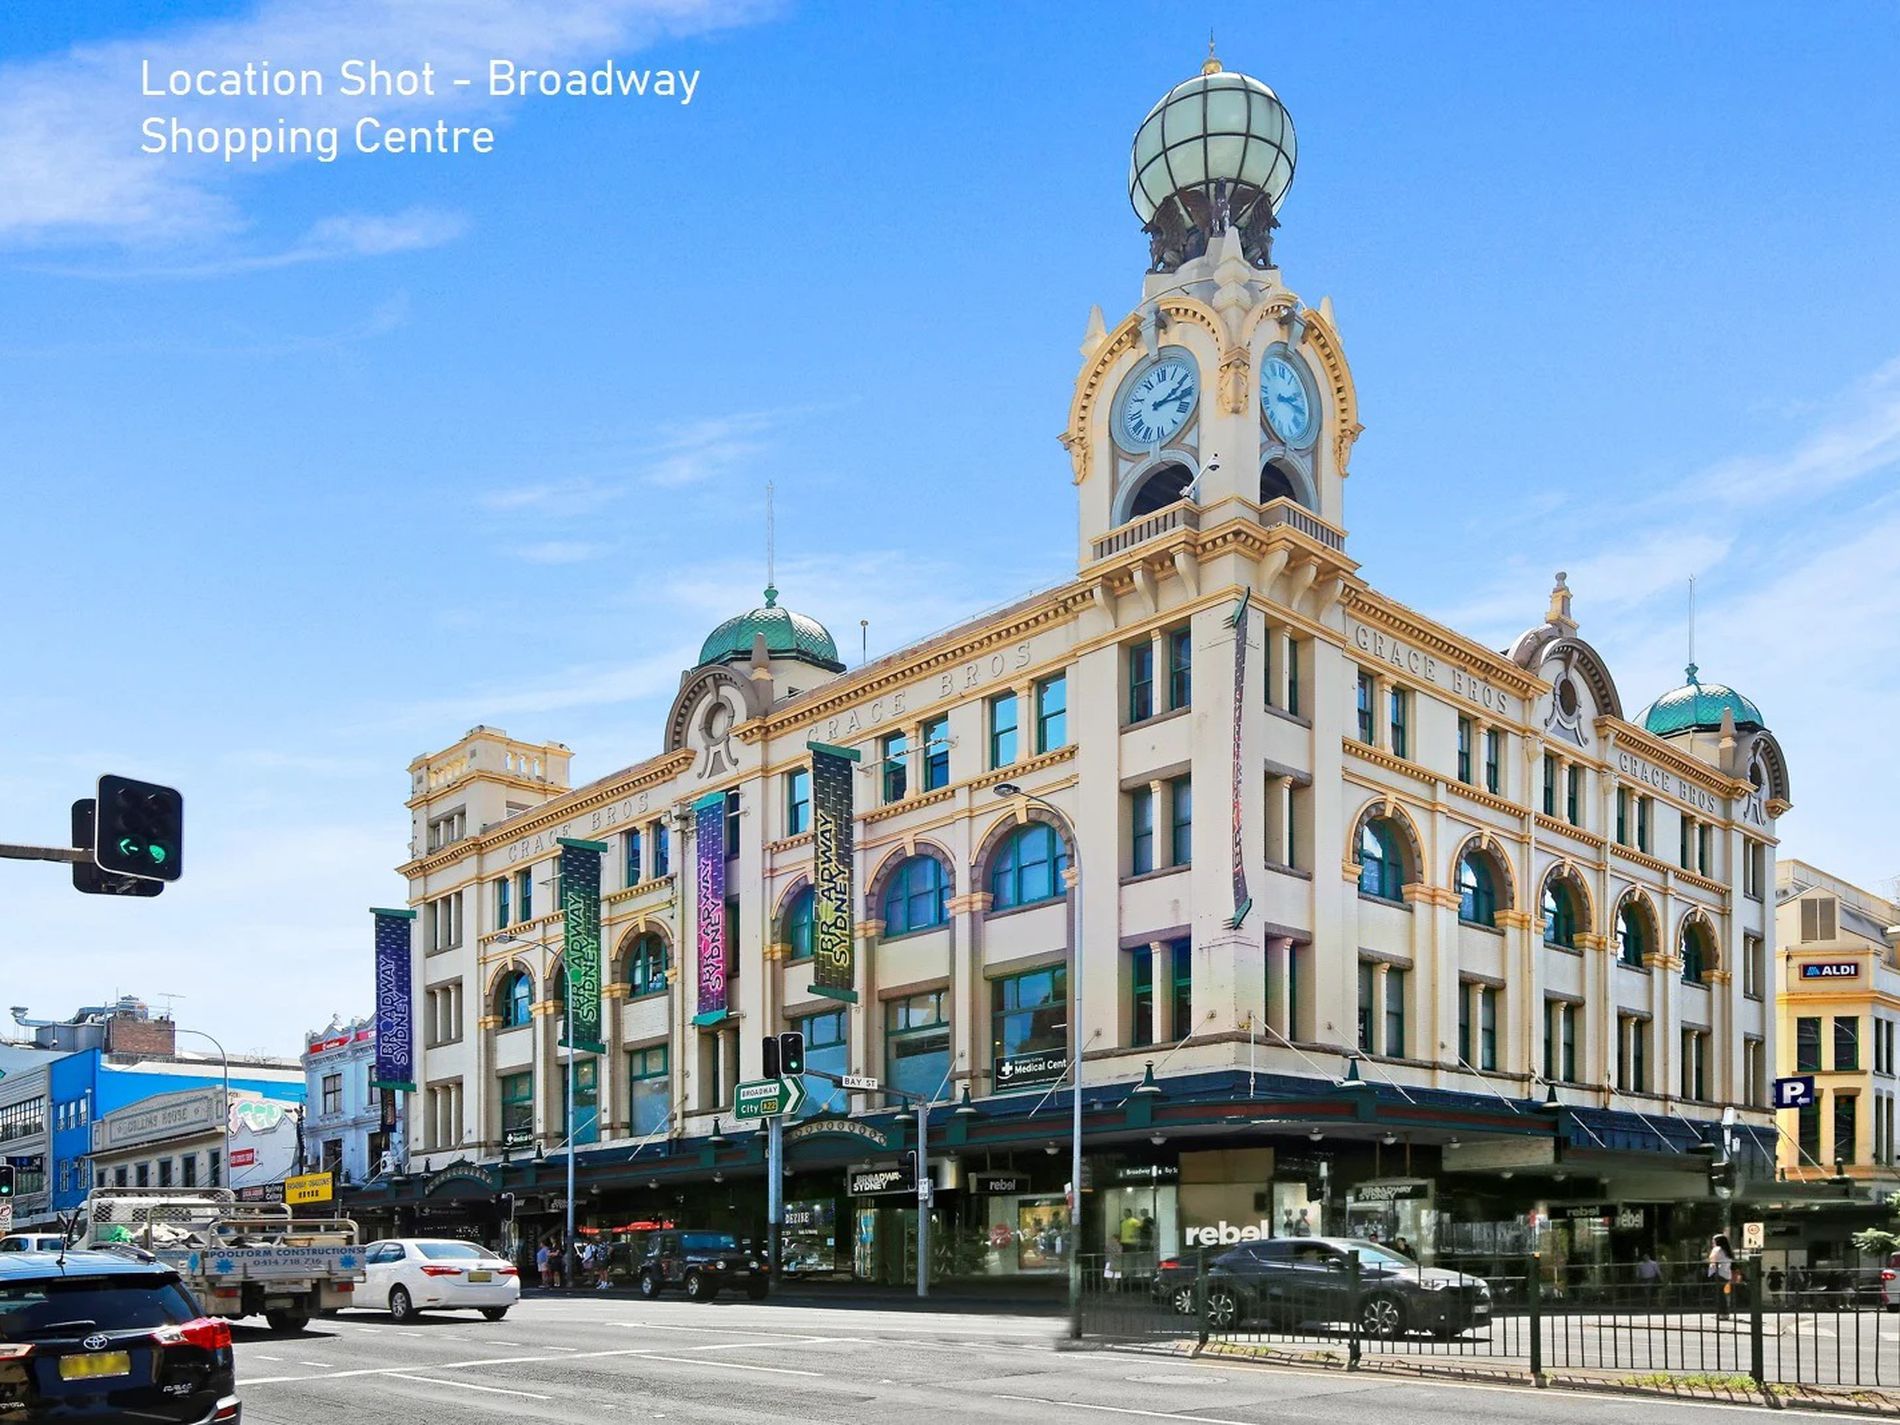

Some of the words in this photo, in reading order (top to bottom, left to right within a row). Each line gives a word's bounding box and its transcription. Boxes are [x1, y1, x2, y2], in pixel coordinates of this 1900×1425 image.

[1355, 624, 1436, 683] GRACE
[1452, 669, 1508, 715] BROS
[806, 690, 906, 742] GRACE
[938, 641, 1031, 699] BROS
[1618, 752, 1670, 793] GRACE
[1679, 780, 1716, 813] BROS
[507, 823, 572, 864] GRACE
[590, 792, 649, 832] BROS
[832, 862, 848, 967] SYDNEY
[710, 899, 722, 991] SYDNEY
[1822, 965, 1856, 975] ALDI
[581, 936, 597, 1022] SYDNEY
[391, 991, 408, 1066] SYDNEY
[1014, 1062, 1046, 1074] Medical
[844, 1077, 862, 1086] BAY
[741, 1086, 778, 1097] BROADWAY
[1782, 1081, 1805, 1104] P
[740, 1104, 759, 1115] City
[762, 1101, 777, 1111] A22
[853, 1180, 888, 1192] SYDNEY
[989, 1179, 1016, 1191] rebel
[1362, 1186, 1412, 1195] BROADWAY
[1359, 1191, 1396, 1200] SYDNEY
[1566, 1206, 1600, 1217] rebel
[1185, 1219, 1269, 1246] rebel
[210, 1250, 272, 1258] POOLFORM
[276, 1247, 366, 1257] CONSTRUCTIONS
